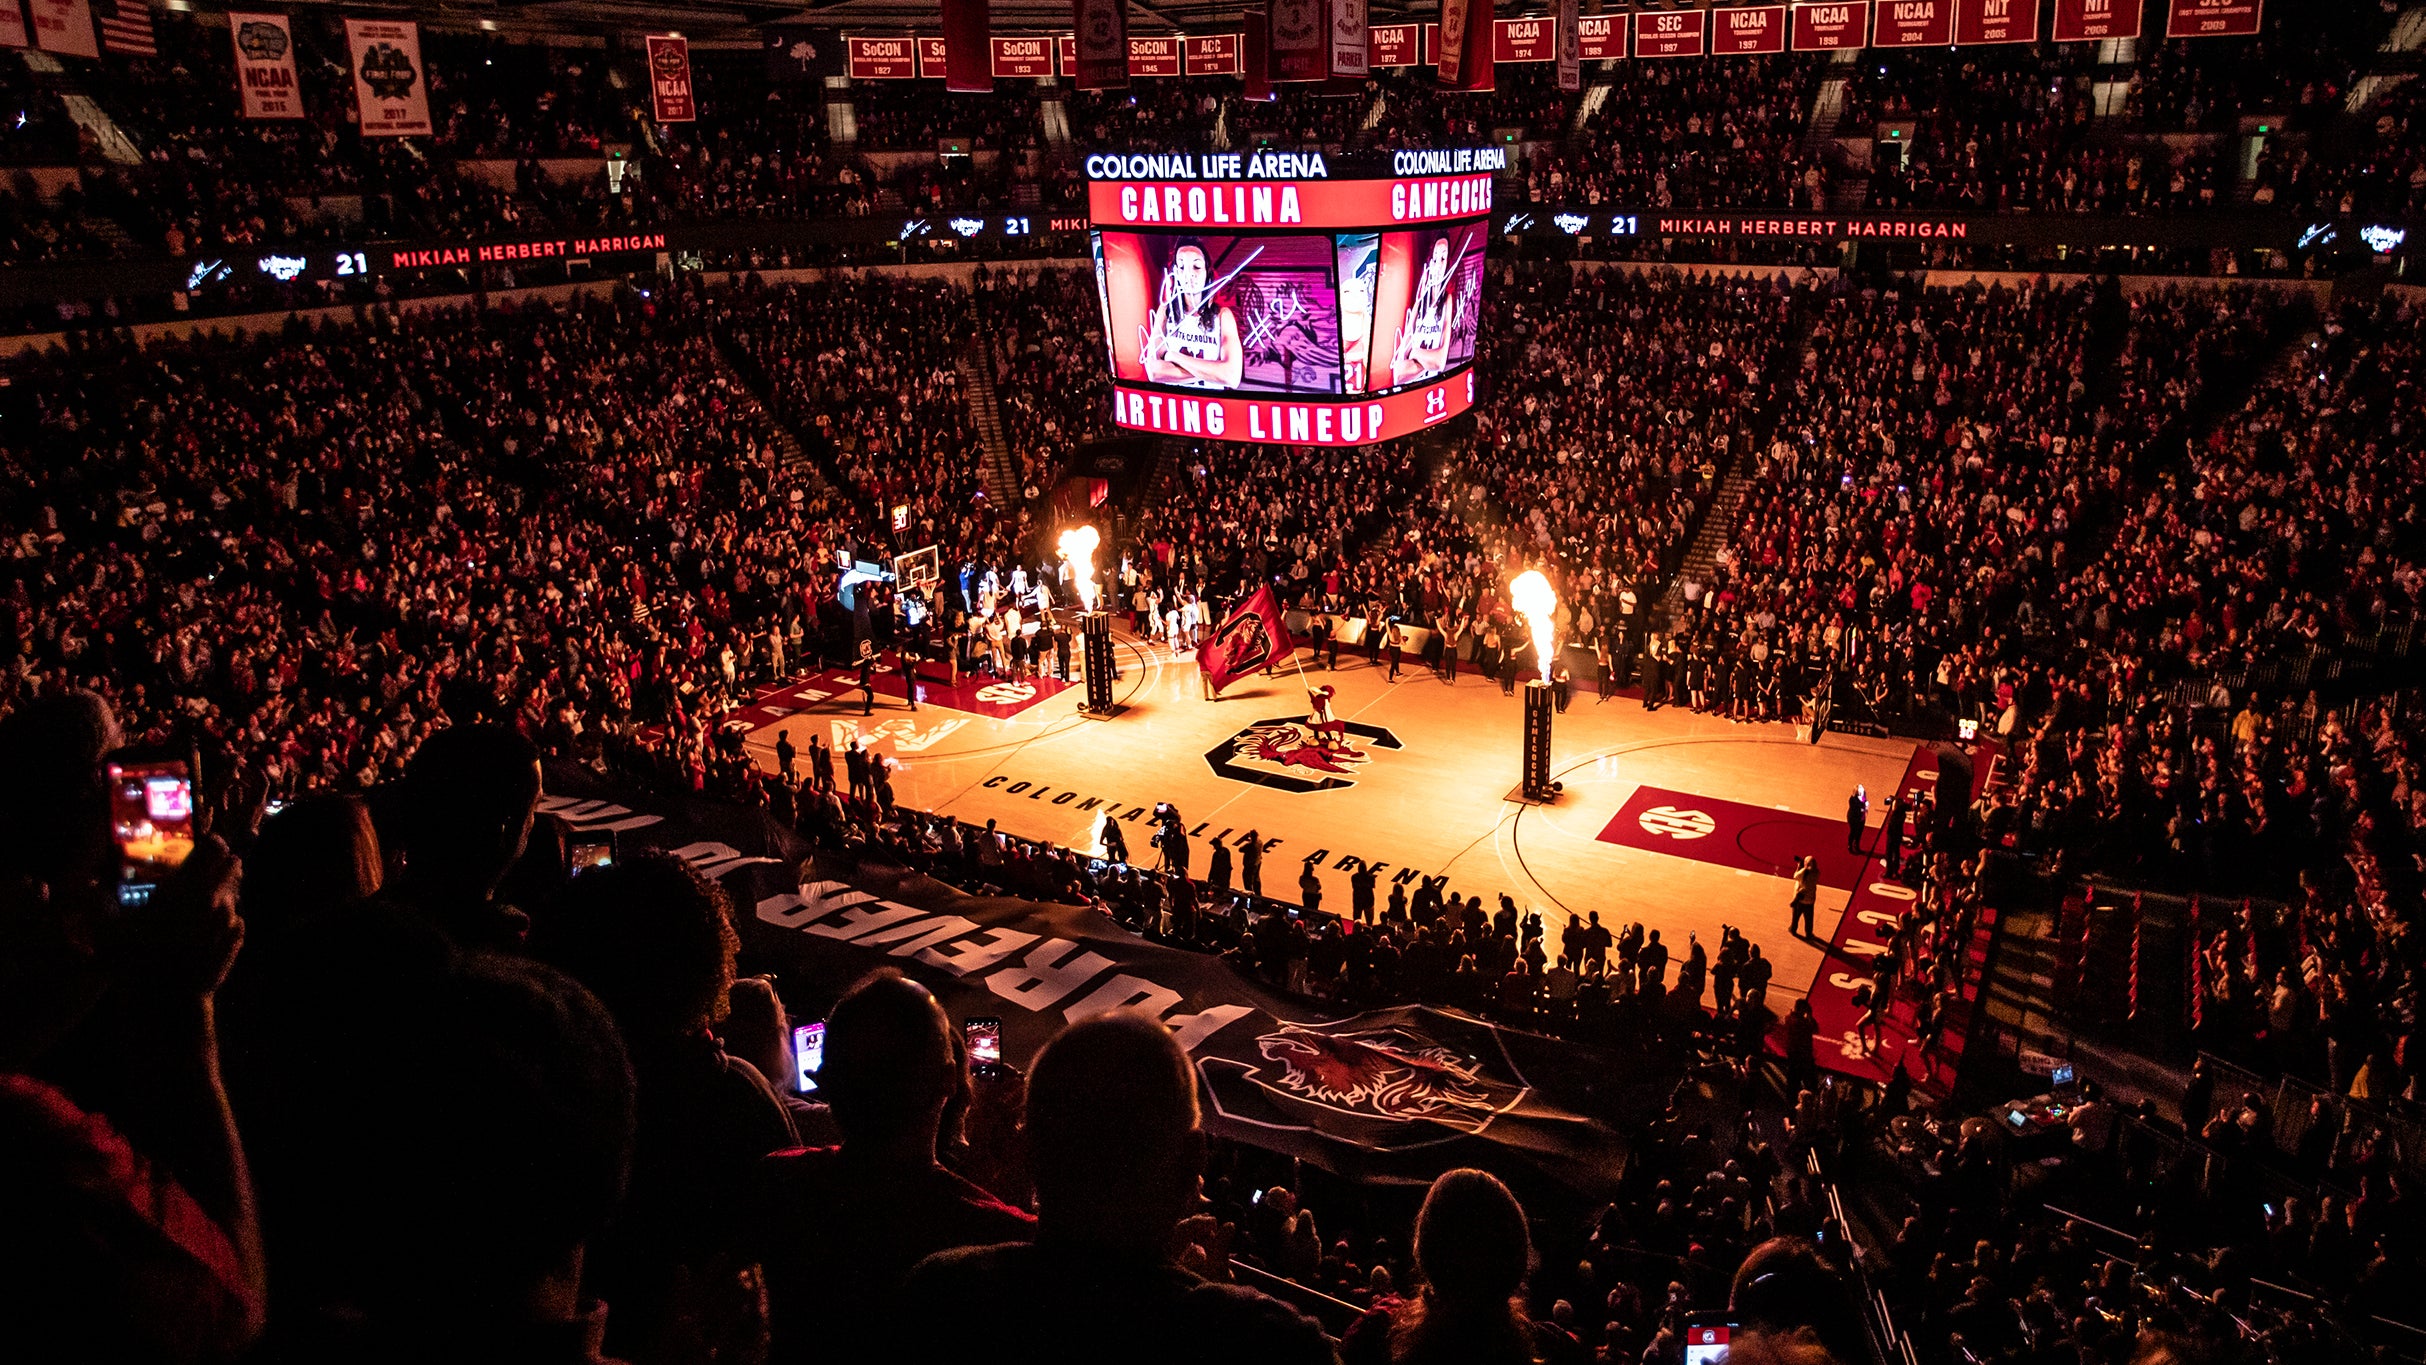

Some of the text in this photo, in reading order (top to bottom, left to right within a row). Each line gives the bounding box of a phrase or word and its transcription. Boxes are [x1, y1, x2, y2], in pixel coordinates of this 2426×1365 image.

[1810, 7, 1849, 24] NCAA
[1894, 2, 1934, 20] NCAA
[1984, 0, 2009, 16] NIT
[1577, 20, 1611, 36] NCAA
[1657, 15, 1682, 32] SEC
[1730, 11, 1767, 29] NCAA
[2200, 20, 2225, 30] 2009
[1374, 29, 1404, 44] NCAA
[1507, 22, 1540, 39] NCAA
[1901, 32, 1923, 42] 2004
[1984, 29, 2006, 39] 2005
[2084, 25, 2107, 35] 2006
[862, 42, 902, 56] SoCON
[1003, 42, 1041, 55] SoCON
[1131, 41, 1168, 55] SoCON
[1201, 39, 1221, 53] ACC
[1660, 43, 1678, 52] 1997
[1739, 40, 1757, 49] 1997
[1337, 51, 1363, 68] PARKER
[1381, 54, 1397, 63] 1972
[1515, 49, 1532, 58] 1974
[874, 66, 891, 74] 1927
[1015, 65, 1031, 73] 1933
[1142, 64, 1158, 73] 1945
[246, 67, 294, 88] NCAA
[657, 80, 688, 97] NCAA
[384, 108, 407, 119] 2017
[1087, 151, 1327, 179] COLONIAL LIFE ARENA
[1394, 147, 1506, 175] COLONIAL LIFE ARENA
[1121, 185, 1301, 223] CAROLINA
[1392, 177, 1492, 220] GAMECOCKS
[1006, 218, 1088, 235] 21 MIKI
[1611, 216, 1966, 238] 21 MIKIAH HERBERT HARRIGAN
[336, 234, 665, 276] 21 MIKIAH HERBERT HARRIGAN
[1344, 363, 1362, 392] 21
[1249, 403, 1384, 442] LINEUP
[895, 515, 906, 530] 30
[1531, 709, 1539, 787] GAMECOCKS
[982, 774, 1162, 828] COLONIAL
[1301, 848, 1451, 893] ARENA
